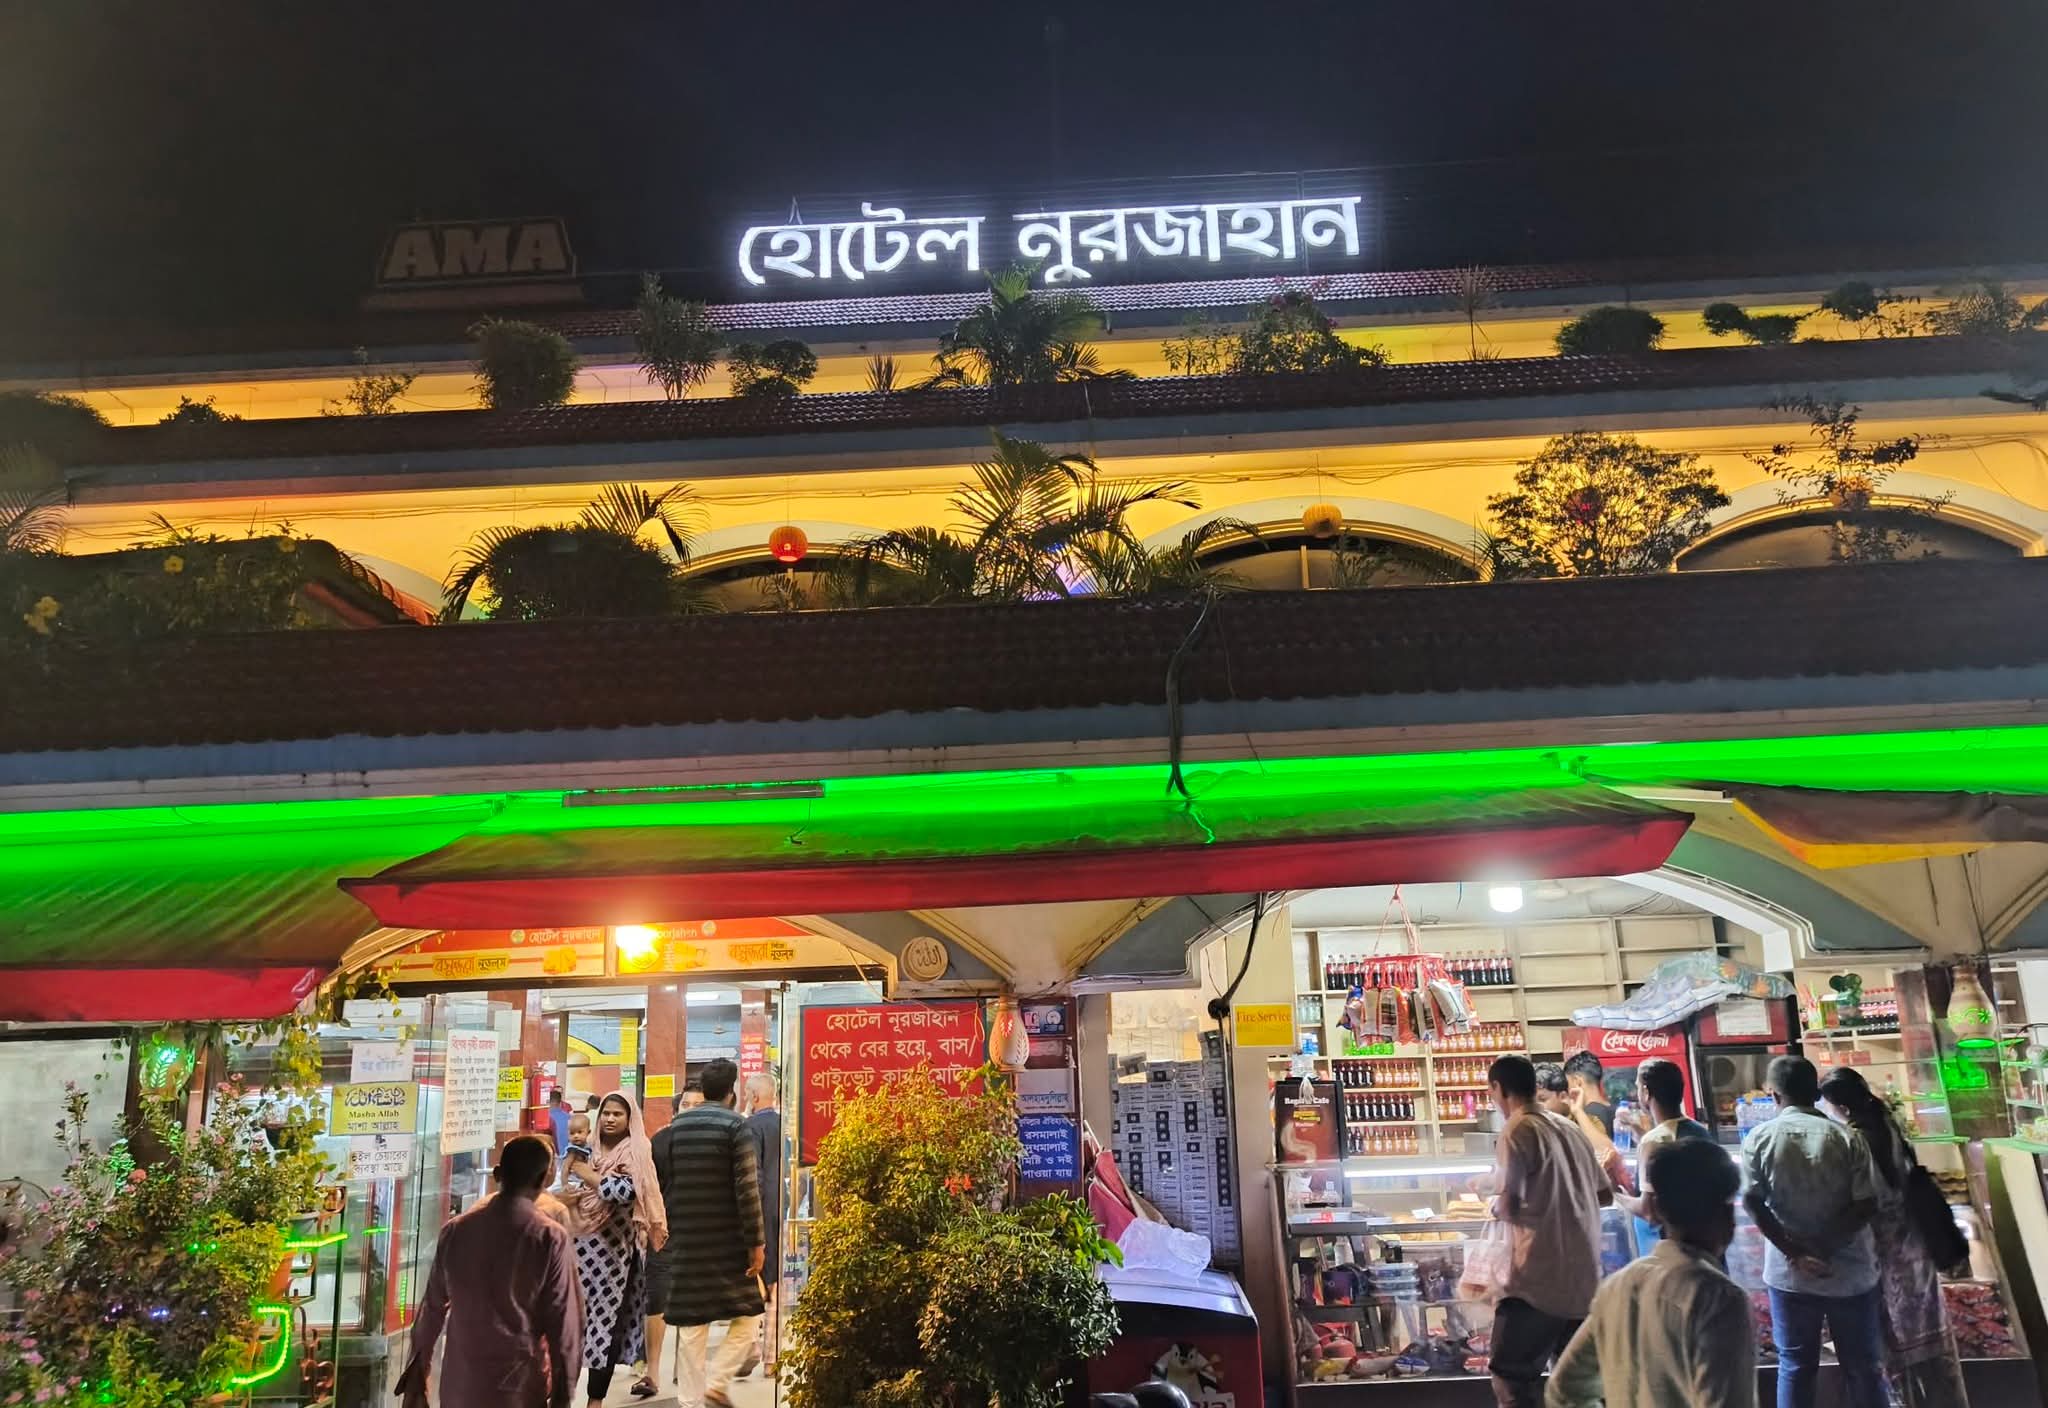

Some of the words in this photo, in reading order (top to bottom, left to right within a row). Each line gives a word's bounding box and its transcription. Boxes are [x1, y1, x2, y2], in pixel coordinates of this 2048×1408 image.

[384, 223, 567, 279] AMA
[739, 202, 986, 286] হোটেল
[826, 1009, 883, 1032] হোটেল
[1236, 1010, 1256, 1022] Fire
[810, 1041, 853, 1060] থেকে
[859, 1040, 889, 1058] বের
[811, 1065, 877, 1088] প্রাইভেট
[348, 1111, 375, 1119] Masha
[378, 1110, 400, 1118] Allah
[348, 1122, 368, 1131] মাশা
[1024, 1128, 1069, 1140] রসমালাই
[1045, 1156, 1055, 1165] ও
